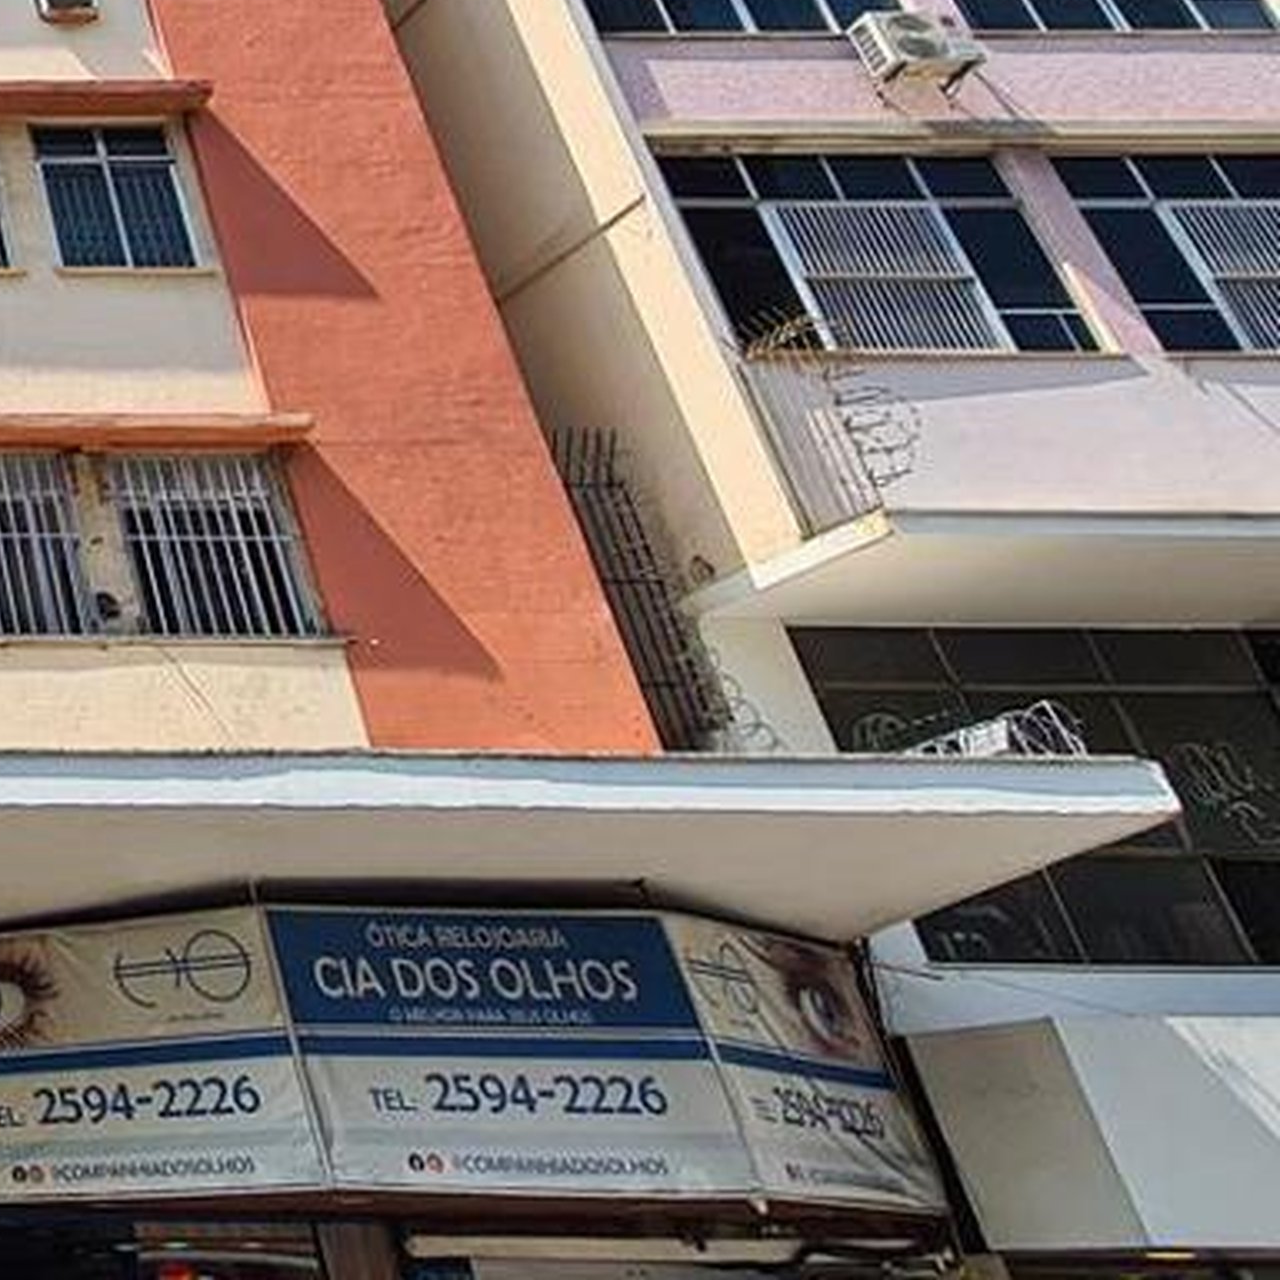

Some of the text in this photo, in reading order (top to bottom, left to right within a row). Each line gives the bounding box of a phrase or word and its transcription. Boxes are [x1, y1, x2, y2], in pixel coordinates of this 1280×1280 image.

[313, 956, 638, 1001] CIA DOS OLHOS
[33, 1075, 262, 1123] 2594-2226
[425, 1074, 668, 1115] 2594-2226
